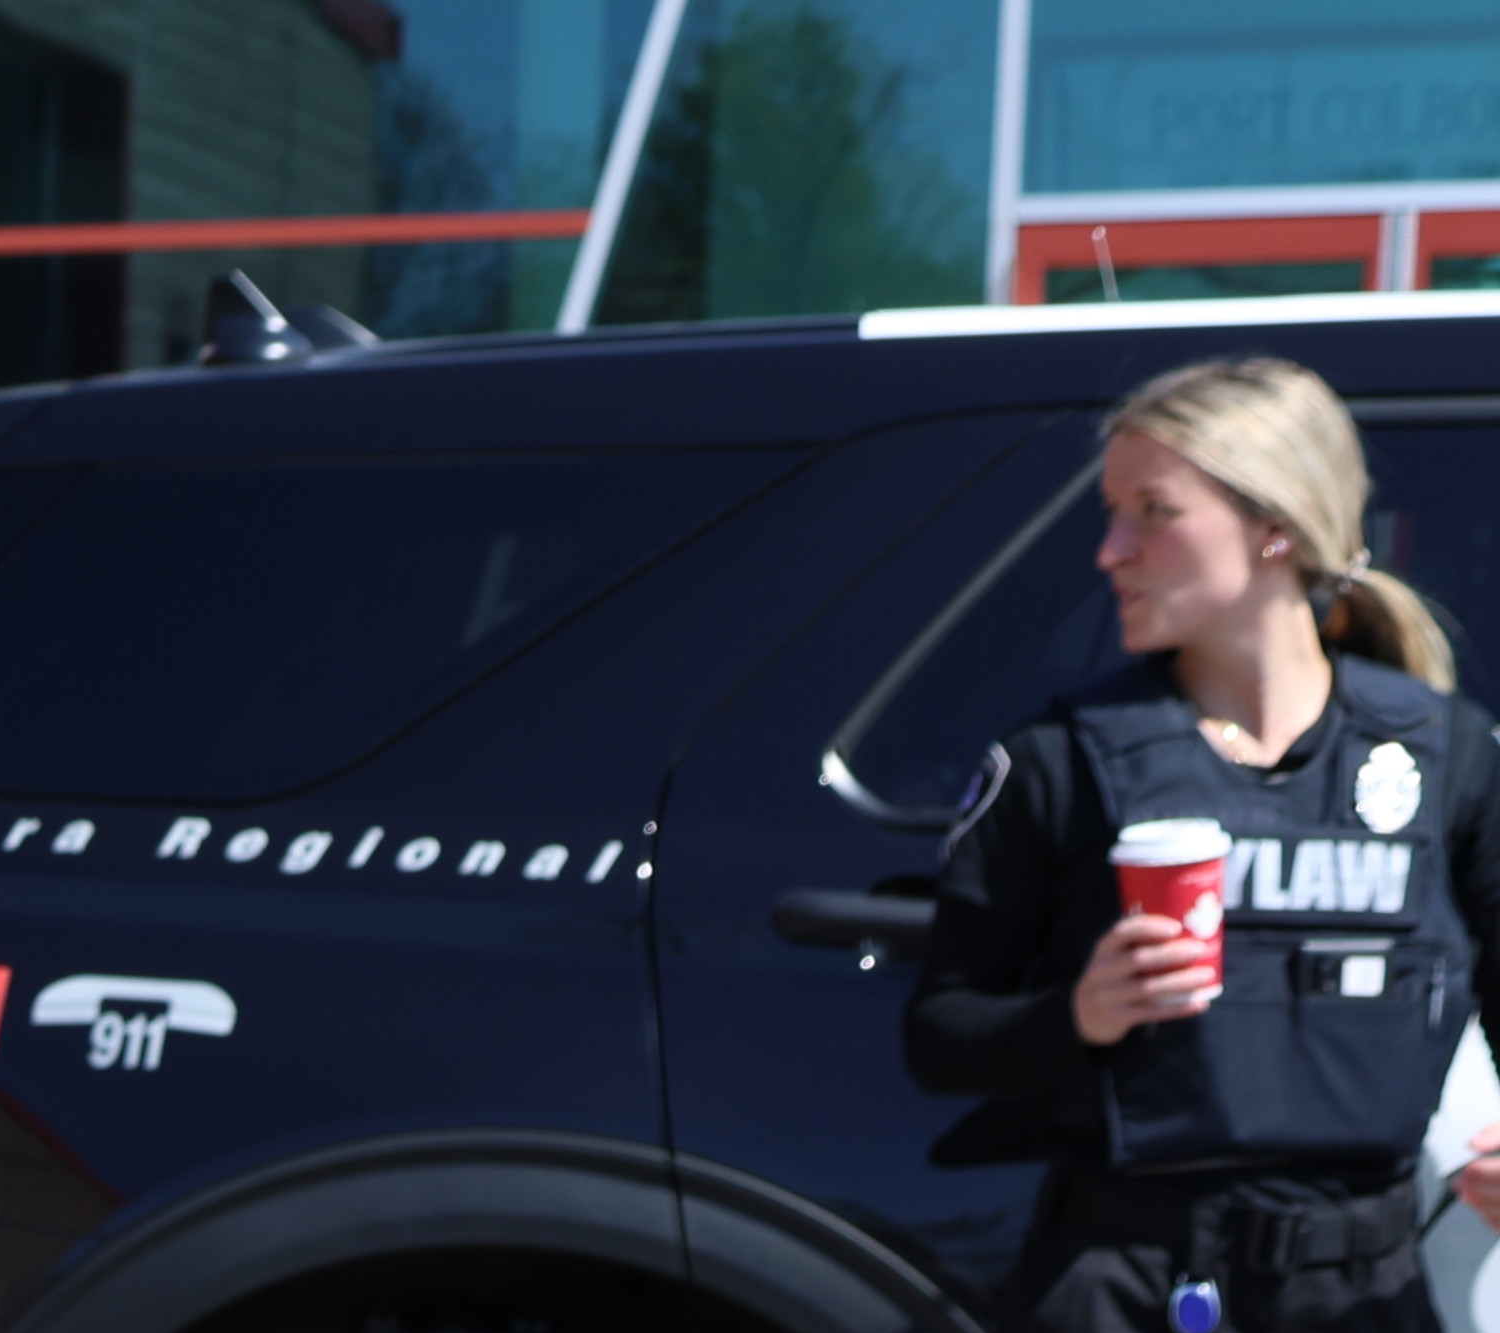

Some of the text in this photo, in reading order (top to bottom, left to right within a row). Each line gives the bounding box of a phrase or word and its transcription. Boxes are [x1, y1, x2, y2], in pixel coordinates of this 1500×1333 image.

[156, 815, 623, 885] Regional
[1224, 839, 1412, 913] YLAW
[86, 1010, 168, 1071] 911
